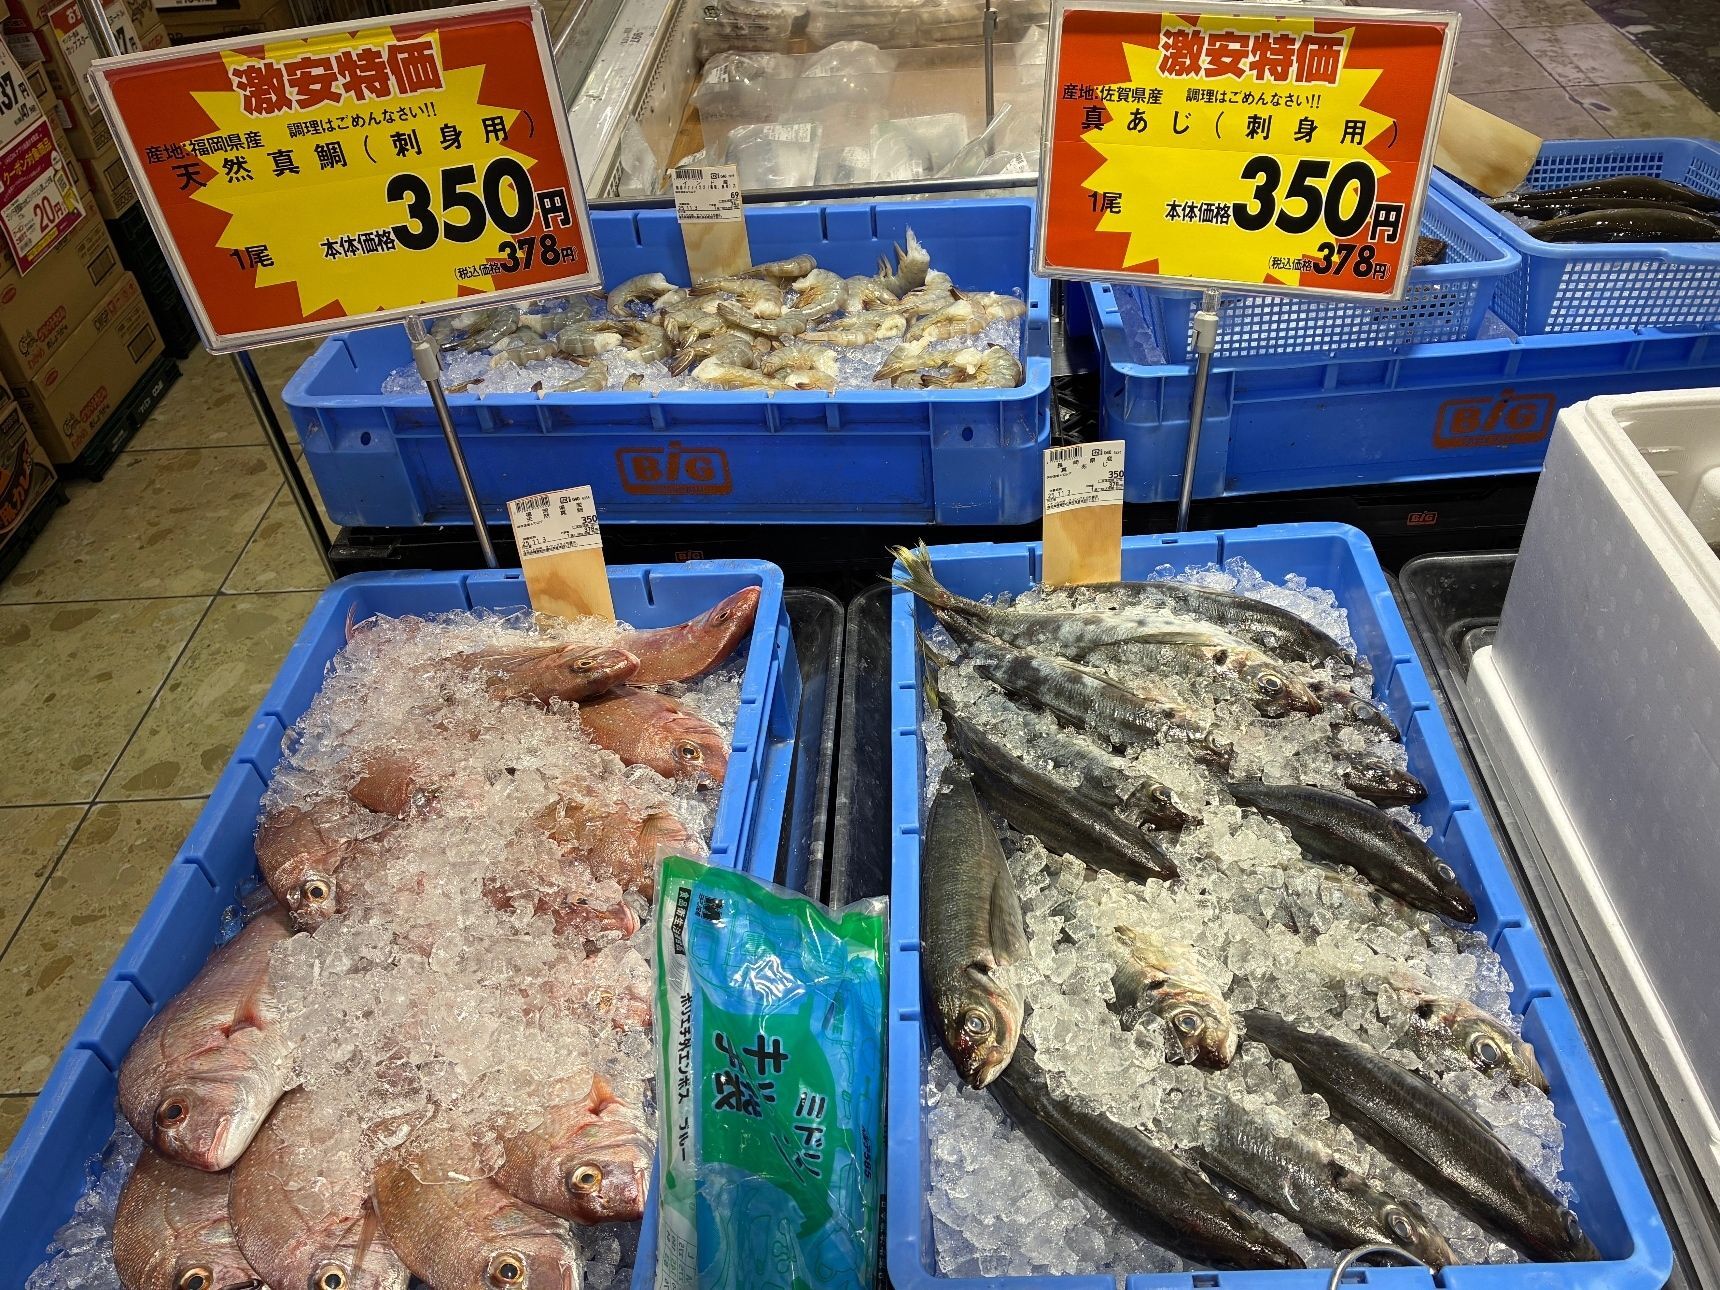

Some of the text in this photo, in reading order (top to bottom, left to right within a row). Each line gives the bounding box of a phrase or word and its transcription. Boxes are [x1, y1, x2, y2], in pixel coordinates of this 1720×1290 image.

[1158, 28, 1347, 86] 激安特価
[232, 40, 443, 118] 激安特価
[1062, 83, 1322, 110] 産地:佐賀県産 調理はごめんなさい!!
[286, 101, 438, 139] 調理はごめんなさい!!
[146, 130, 265, 165] 産地:福岡県産
[1088, 190, 1123, 216] 1尾
[230, 245, 274, 271] 1尾
[1108, 470, 1124, 479] 350
[581, 514, 598, 525] 350
